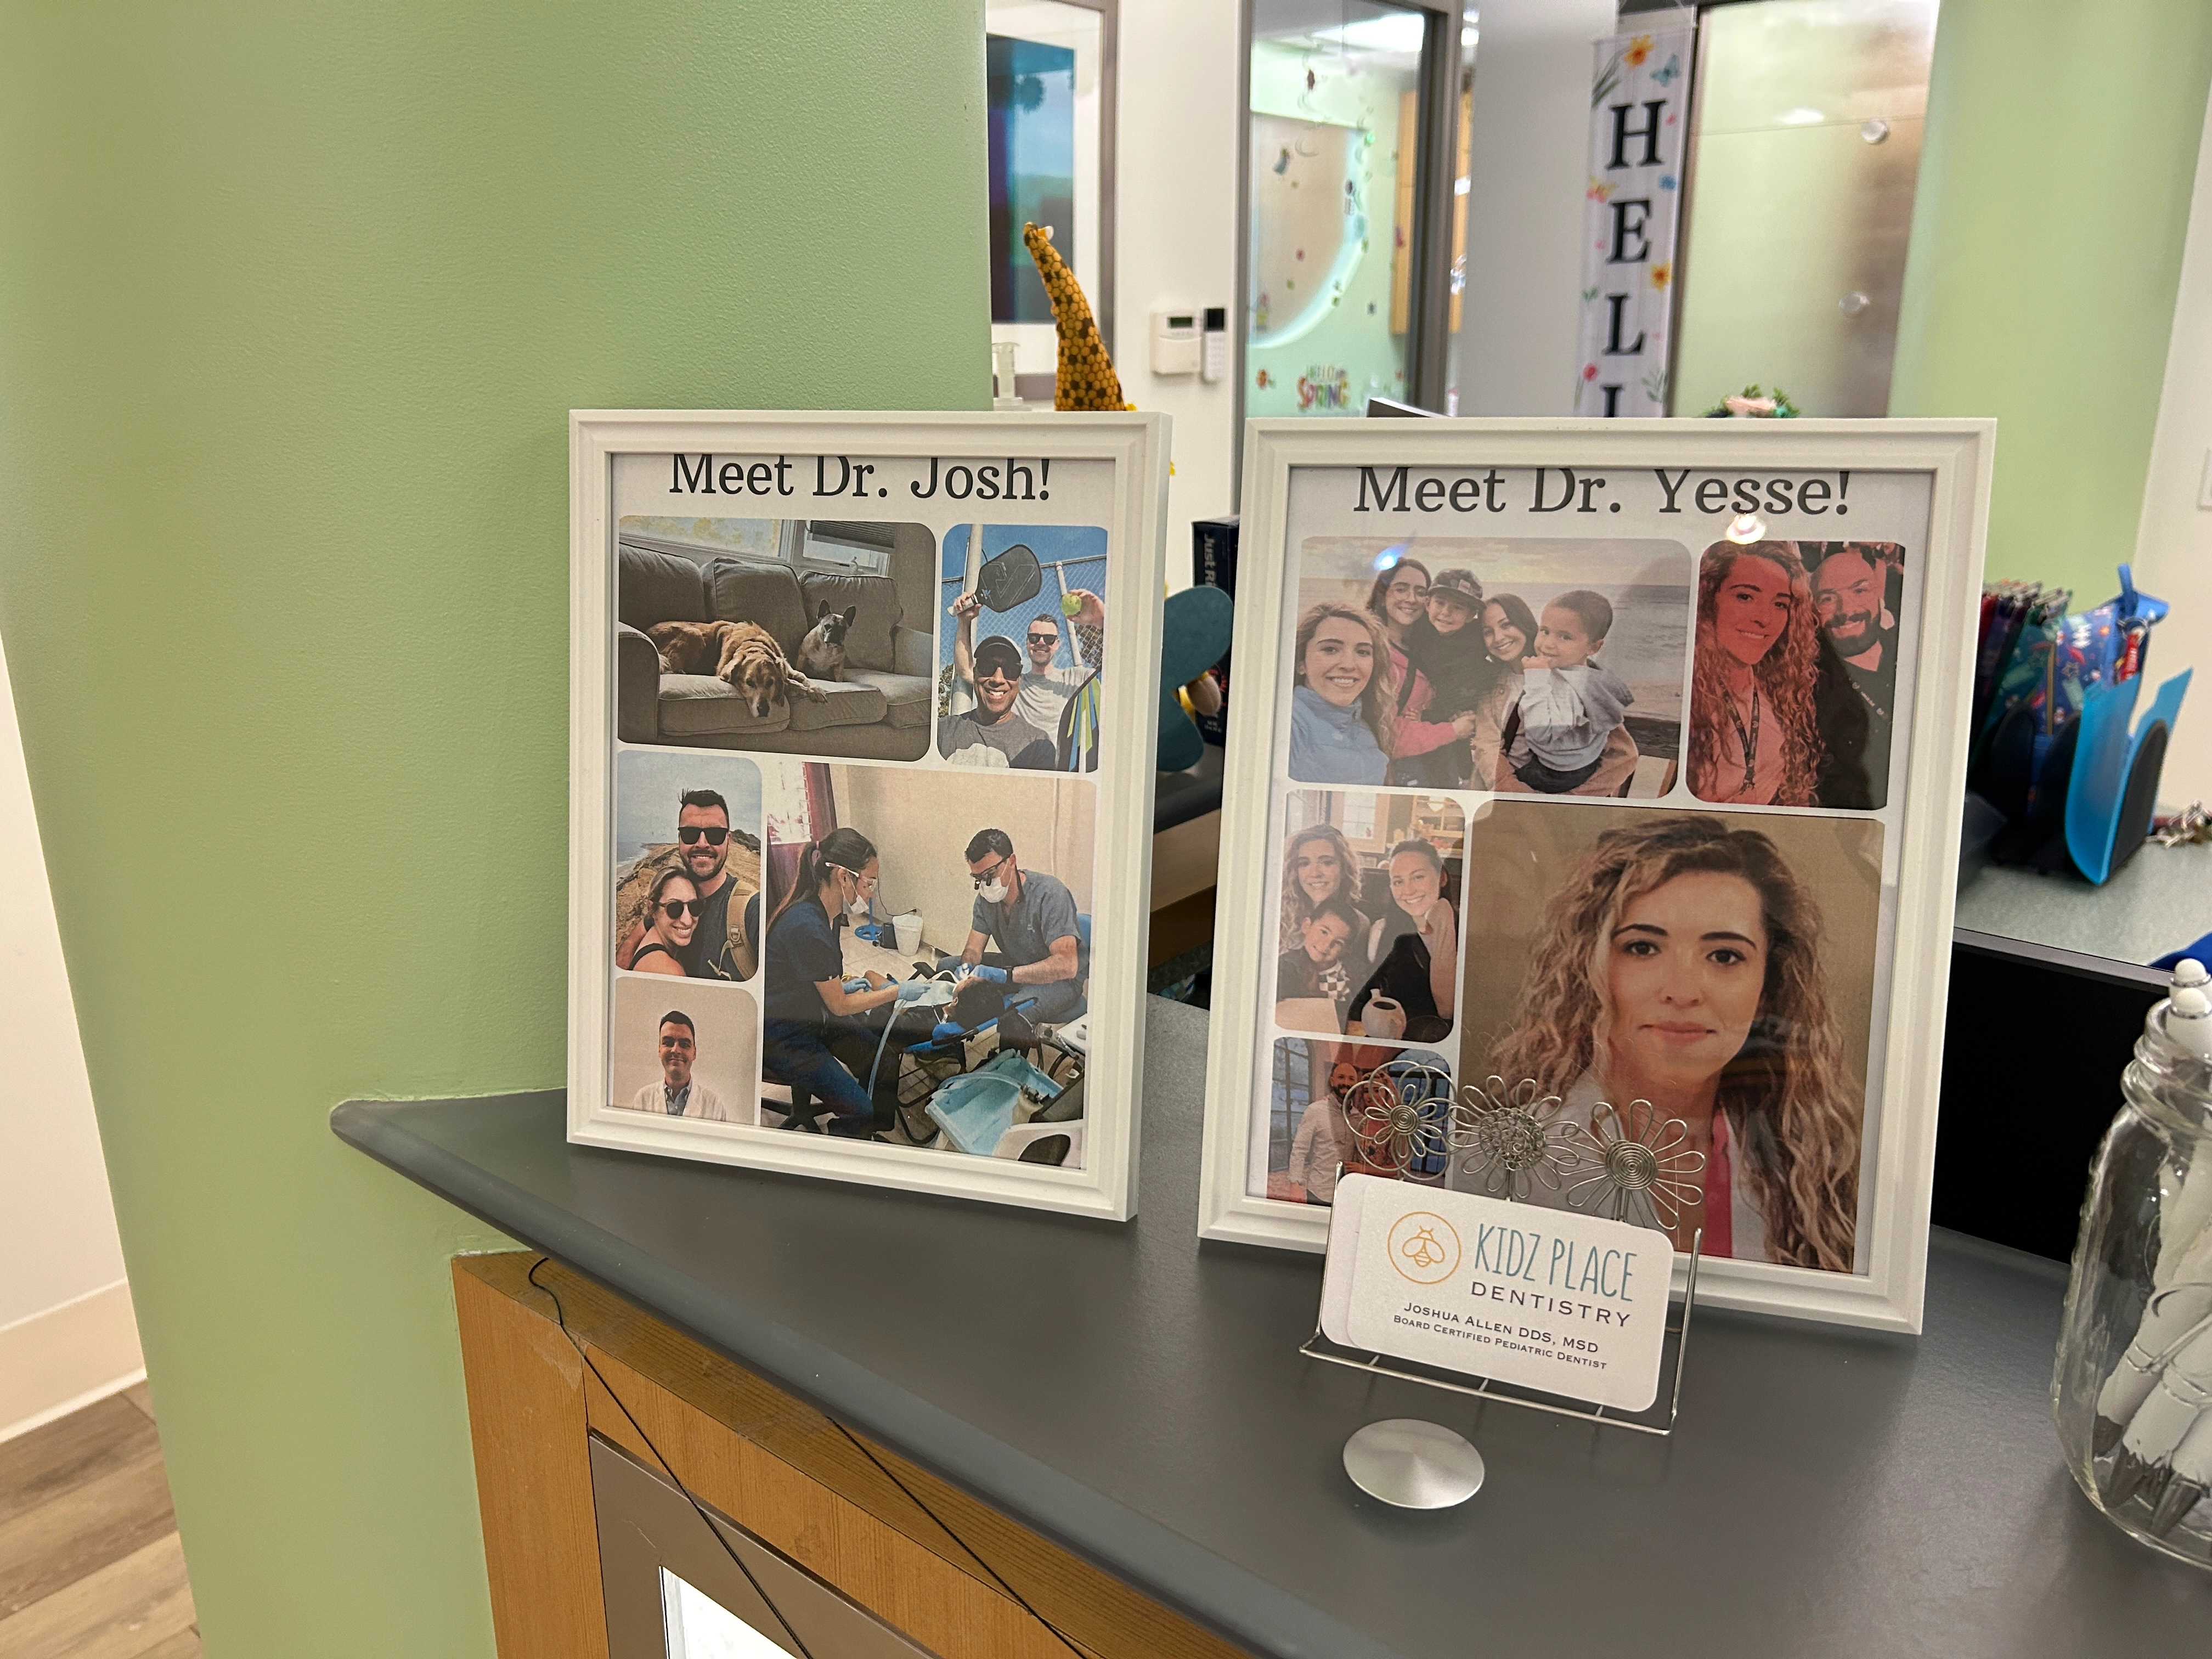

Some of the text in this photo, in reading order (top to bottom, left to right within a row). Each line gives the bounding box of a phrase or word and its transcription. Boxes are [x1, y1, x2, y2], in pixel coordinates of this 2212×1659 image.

[669, 454, 1051, 501] Meet Dr. Josh!
[1353, 467, 1852, 516] Meet Dr. Yesse!
[1474, 1223, 1638, 1302] KIDZ PLACE
[1403, 1302, 1599, 1353] JOSHUA ALLEN DDS, MSD
[1471, 1281, 1631, 1328] DENTISTRY
[1393, 1314, 1607, 1370] BOARD CERTIFIED PEDIATRIC DENTIST
